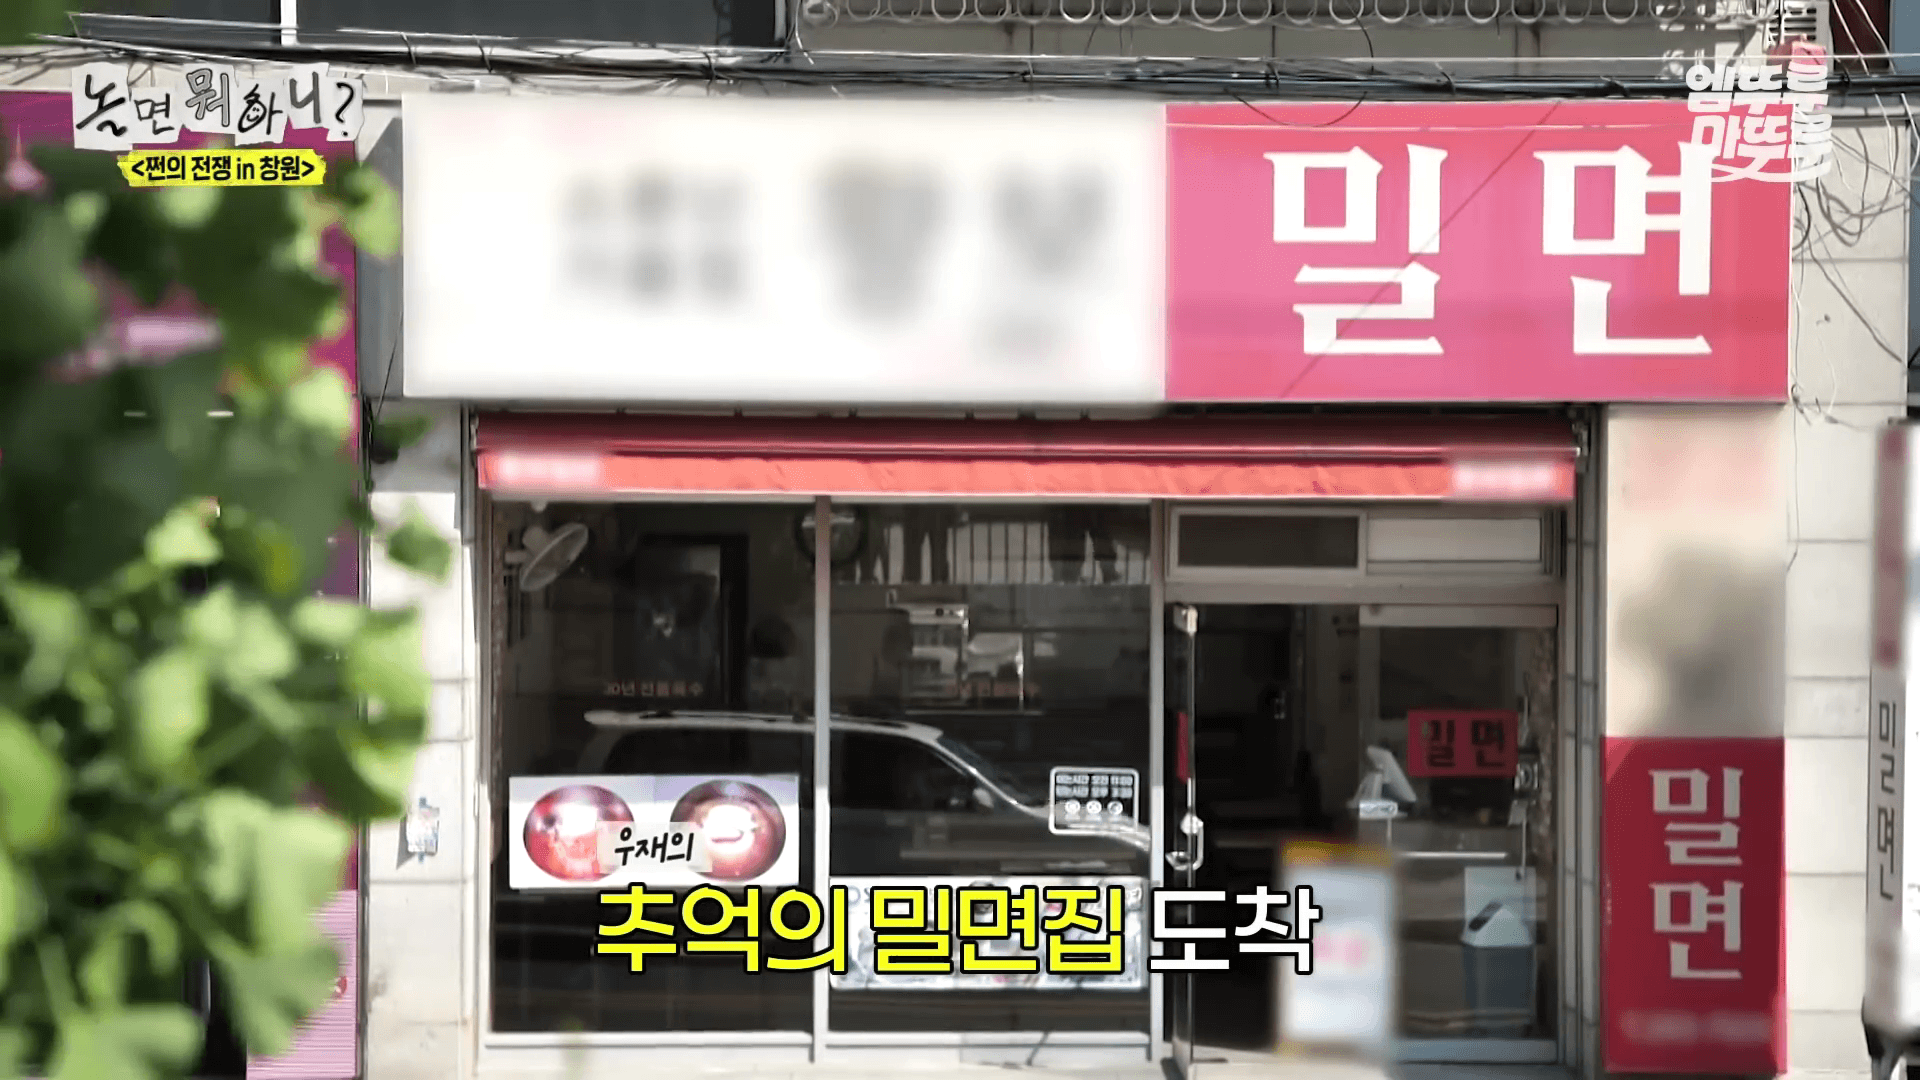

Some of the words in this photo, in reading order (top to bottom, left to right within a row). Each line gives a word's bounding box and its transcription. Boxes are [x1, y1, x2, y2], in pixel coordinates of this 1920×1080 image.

[1265, 143, 1714, 355] 밀면
[1423, 718, 1506, 768] 밀면
[1648, 766, 1744, 979] 밀면
